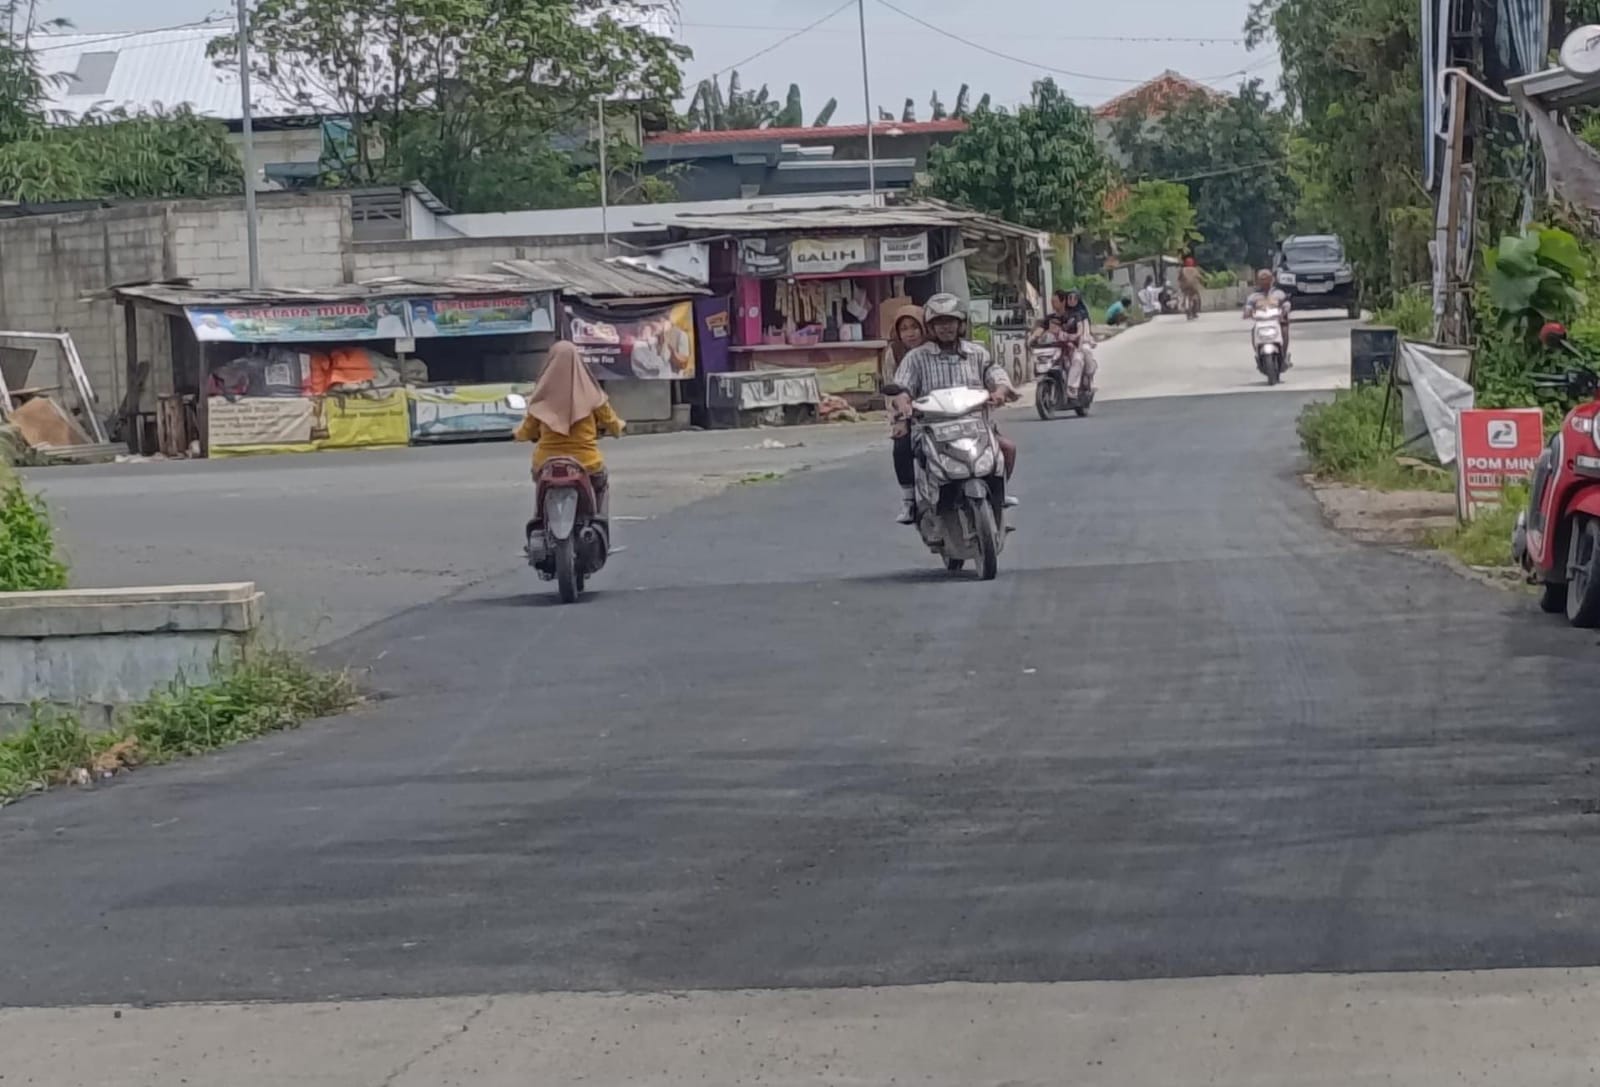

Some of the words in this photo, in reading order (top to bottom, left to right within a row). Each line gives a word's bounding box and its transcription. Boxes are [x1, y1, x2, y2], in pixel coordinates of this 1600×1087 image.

[797, 250, 856, 263] GALIH
[250, 307, 311, 319] KELAPA
[317, 304, 369, 316] MUDA
[1467, 457, 1502, 470] POM
[1505, 457, 1537, 470] MIN
